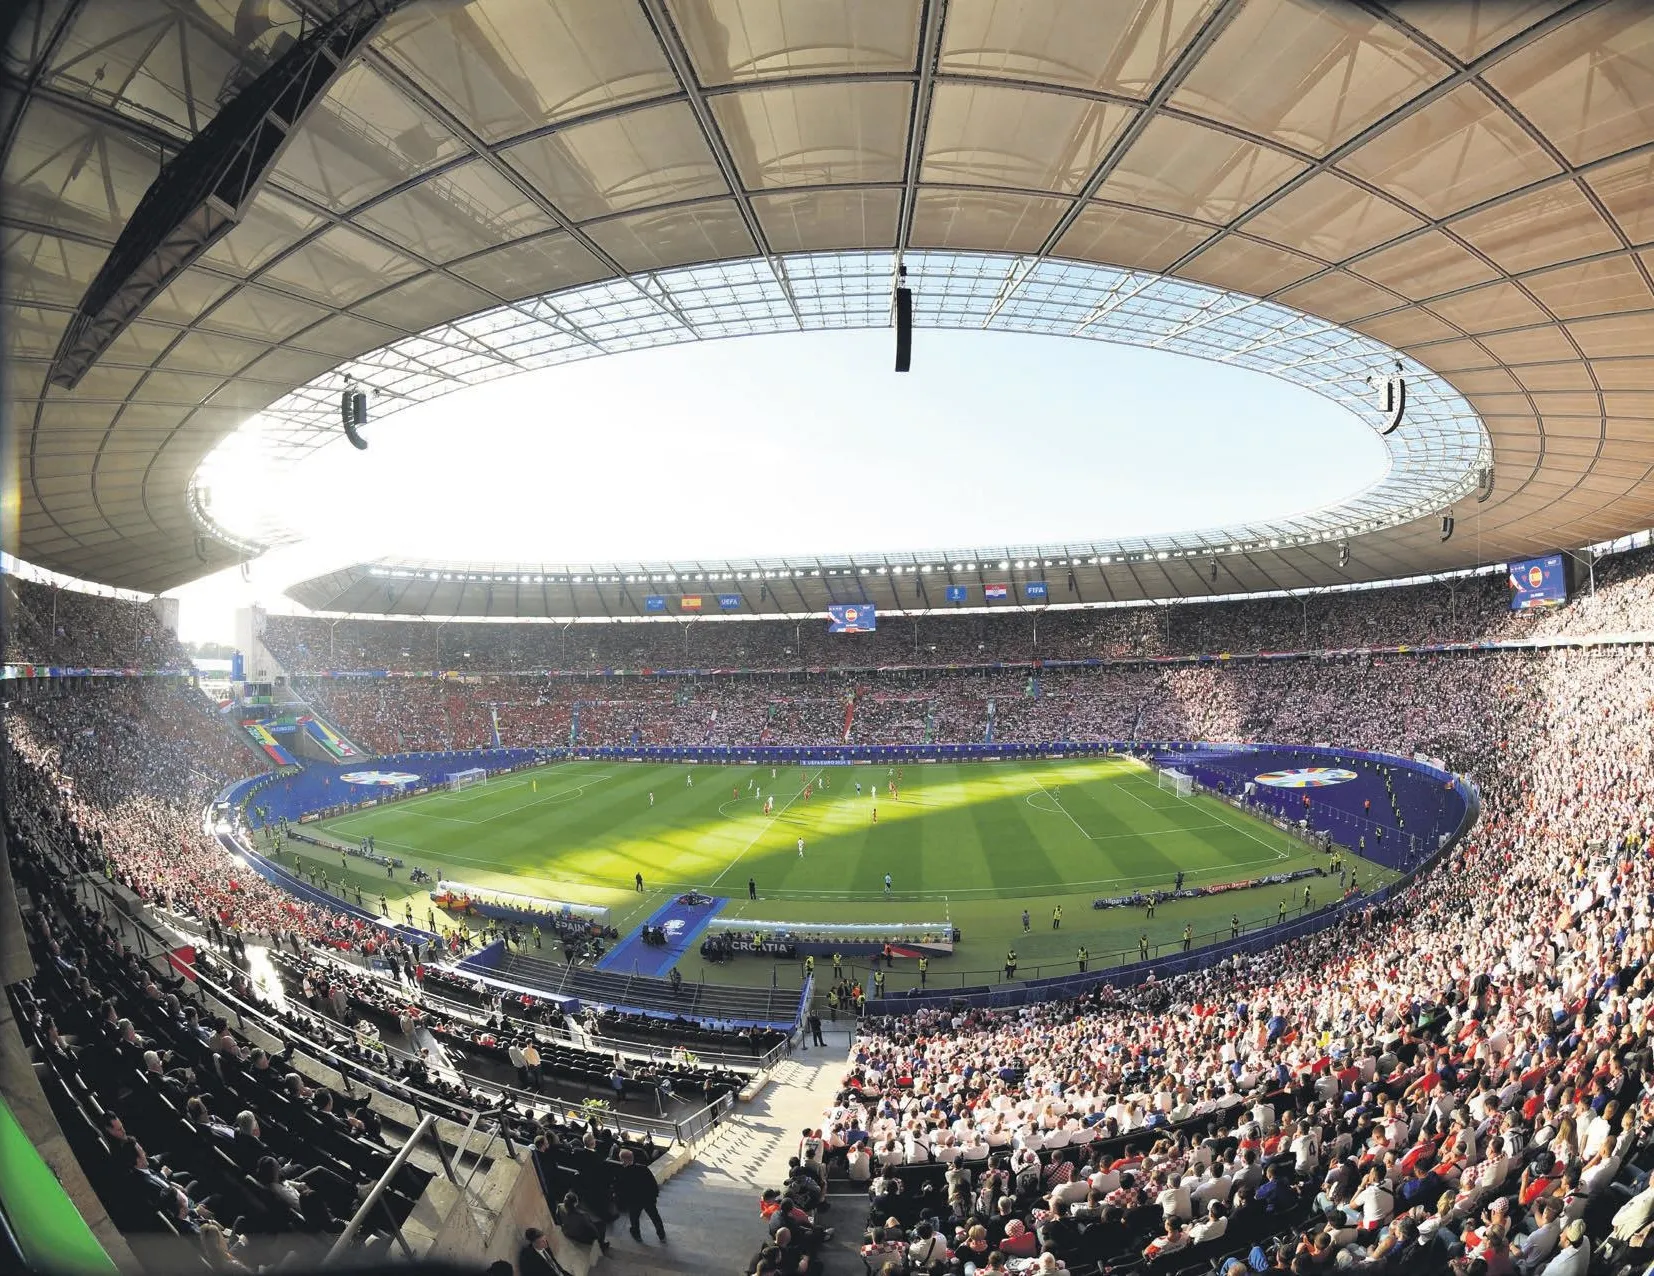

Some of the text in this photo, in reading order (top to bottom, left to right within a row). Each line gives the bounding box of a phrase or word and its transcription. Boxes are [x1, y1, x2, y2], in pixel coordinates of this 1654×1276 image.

[1028, 586, 1044, 594] FIFA
[555, 920, 585, 932] SPAIN
[731, 941, 788, 953] CROATIA
[834, 1110, 843, 1120] 9
